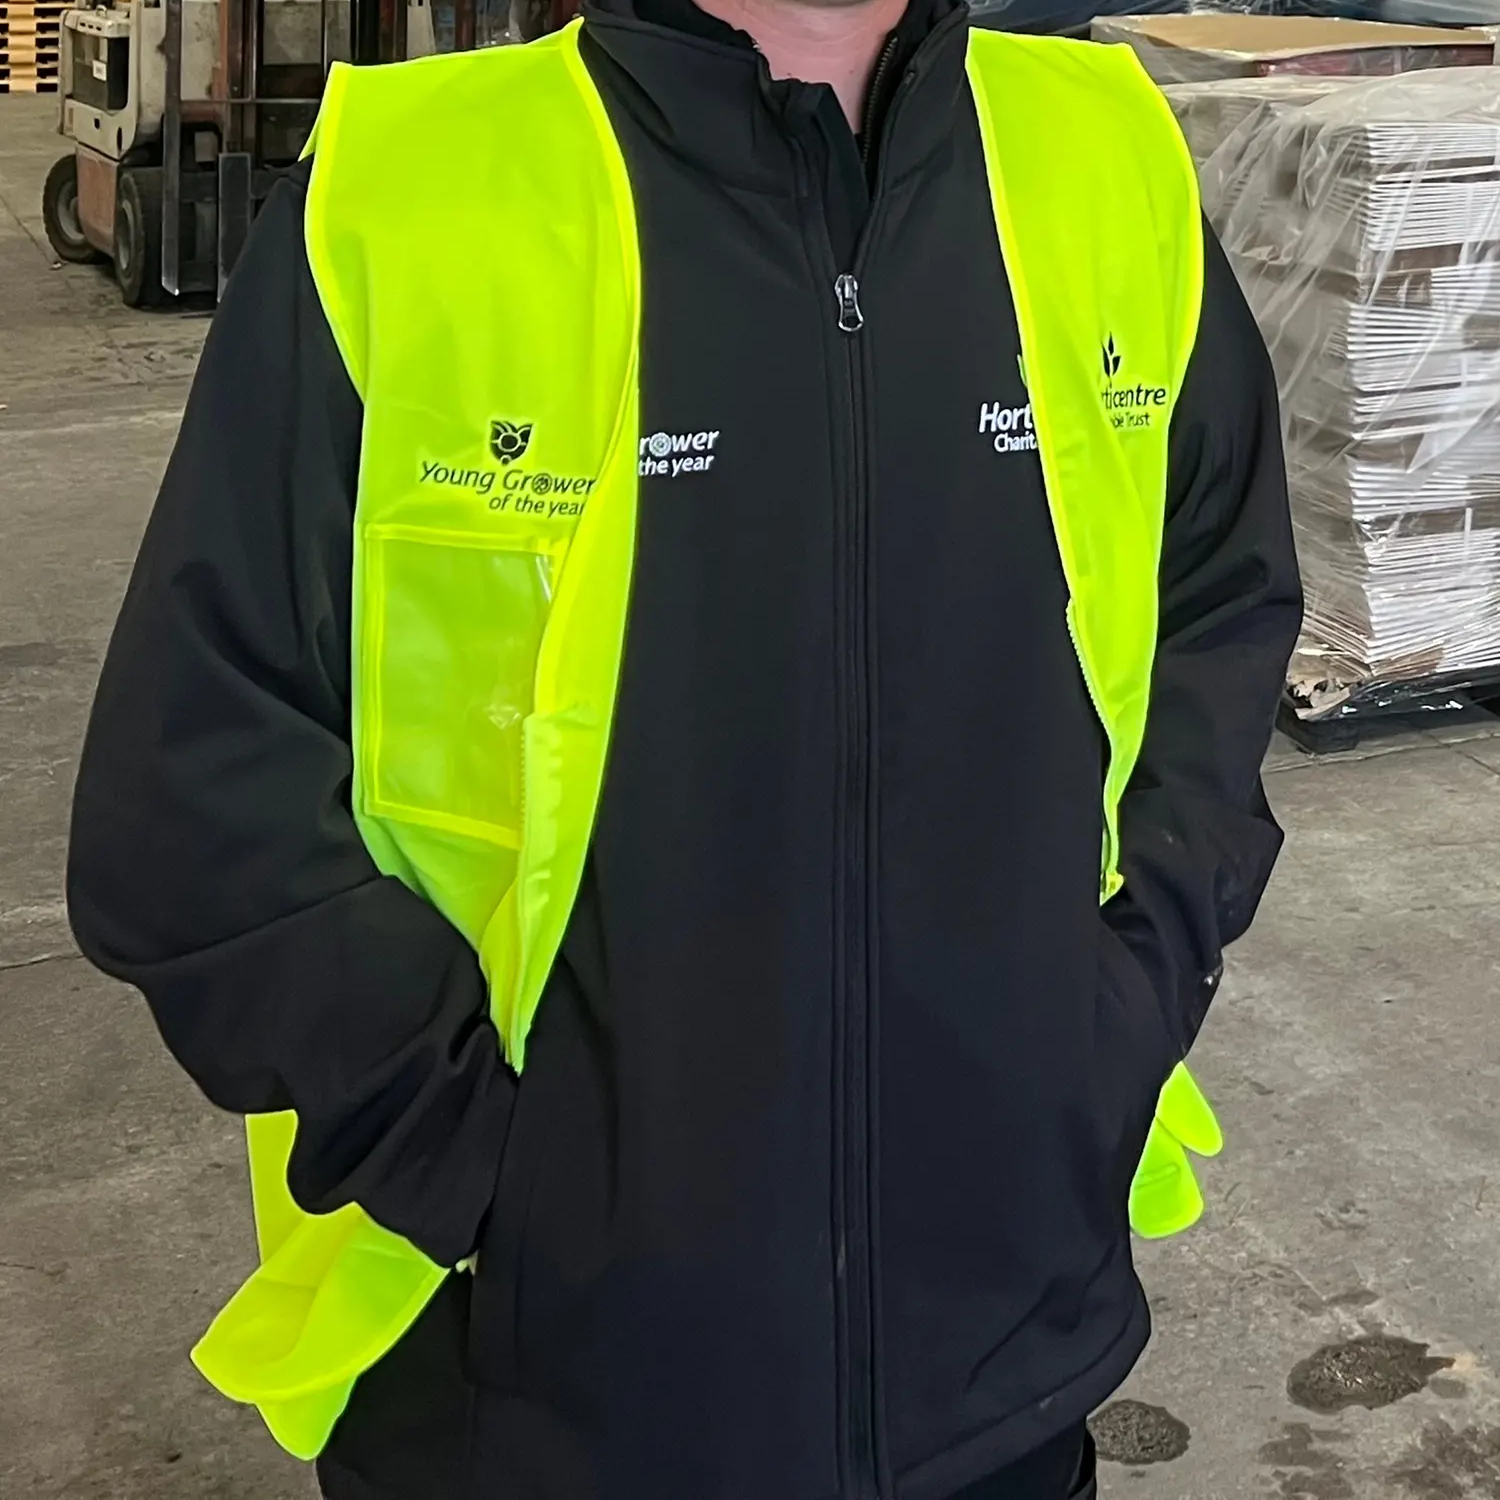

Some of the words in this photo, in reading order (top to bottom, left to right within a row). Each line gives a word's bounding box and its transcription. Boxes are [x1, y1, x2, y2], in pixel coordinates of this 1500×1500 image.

[1101, 382, 1166, 410] rticentre
[979, 401, 1033, 433] Hort
[639, 430, 720, 457] rower
[994, 430, 1037, 452] Charit
[419, 460, 497, 495] Young
[503, 469, 597, 496] Grower
[638, 456, 669, 476] the
[671, 455, 715, 478] year
[488, 493, 513, 511] of
[515, 494, 544, 513] the
